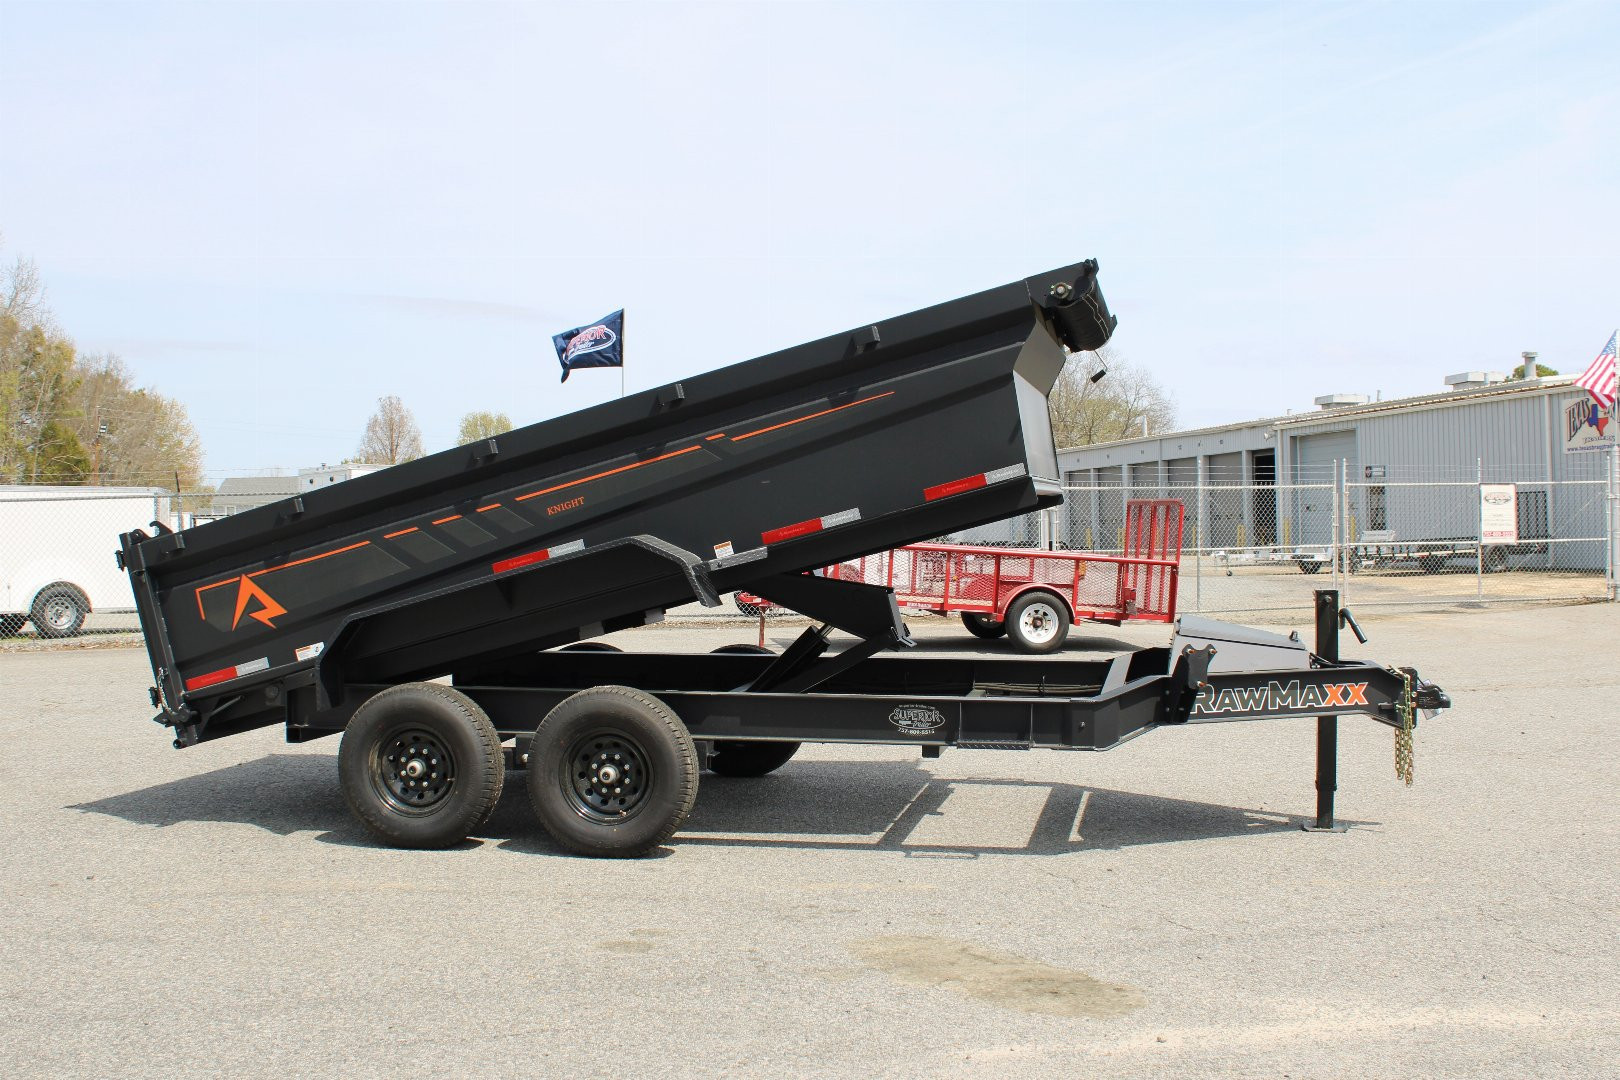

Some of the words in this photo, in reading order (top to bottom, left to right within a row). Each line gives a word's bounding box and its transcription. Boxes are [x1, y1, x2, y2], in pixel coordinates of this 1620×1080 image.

[1565, 397, 1591, 442] TEXAS
[547, 496, 585, 516] KNIGHT
[893, 708, 941, 722] SUPERIOR
